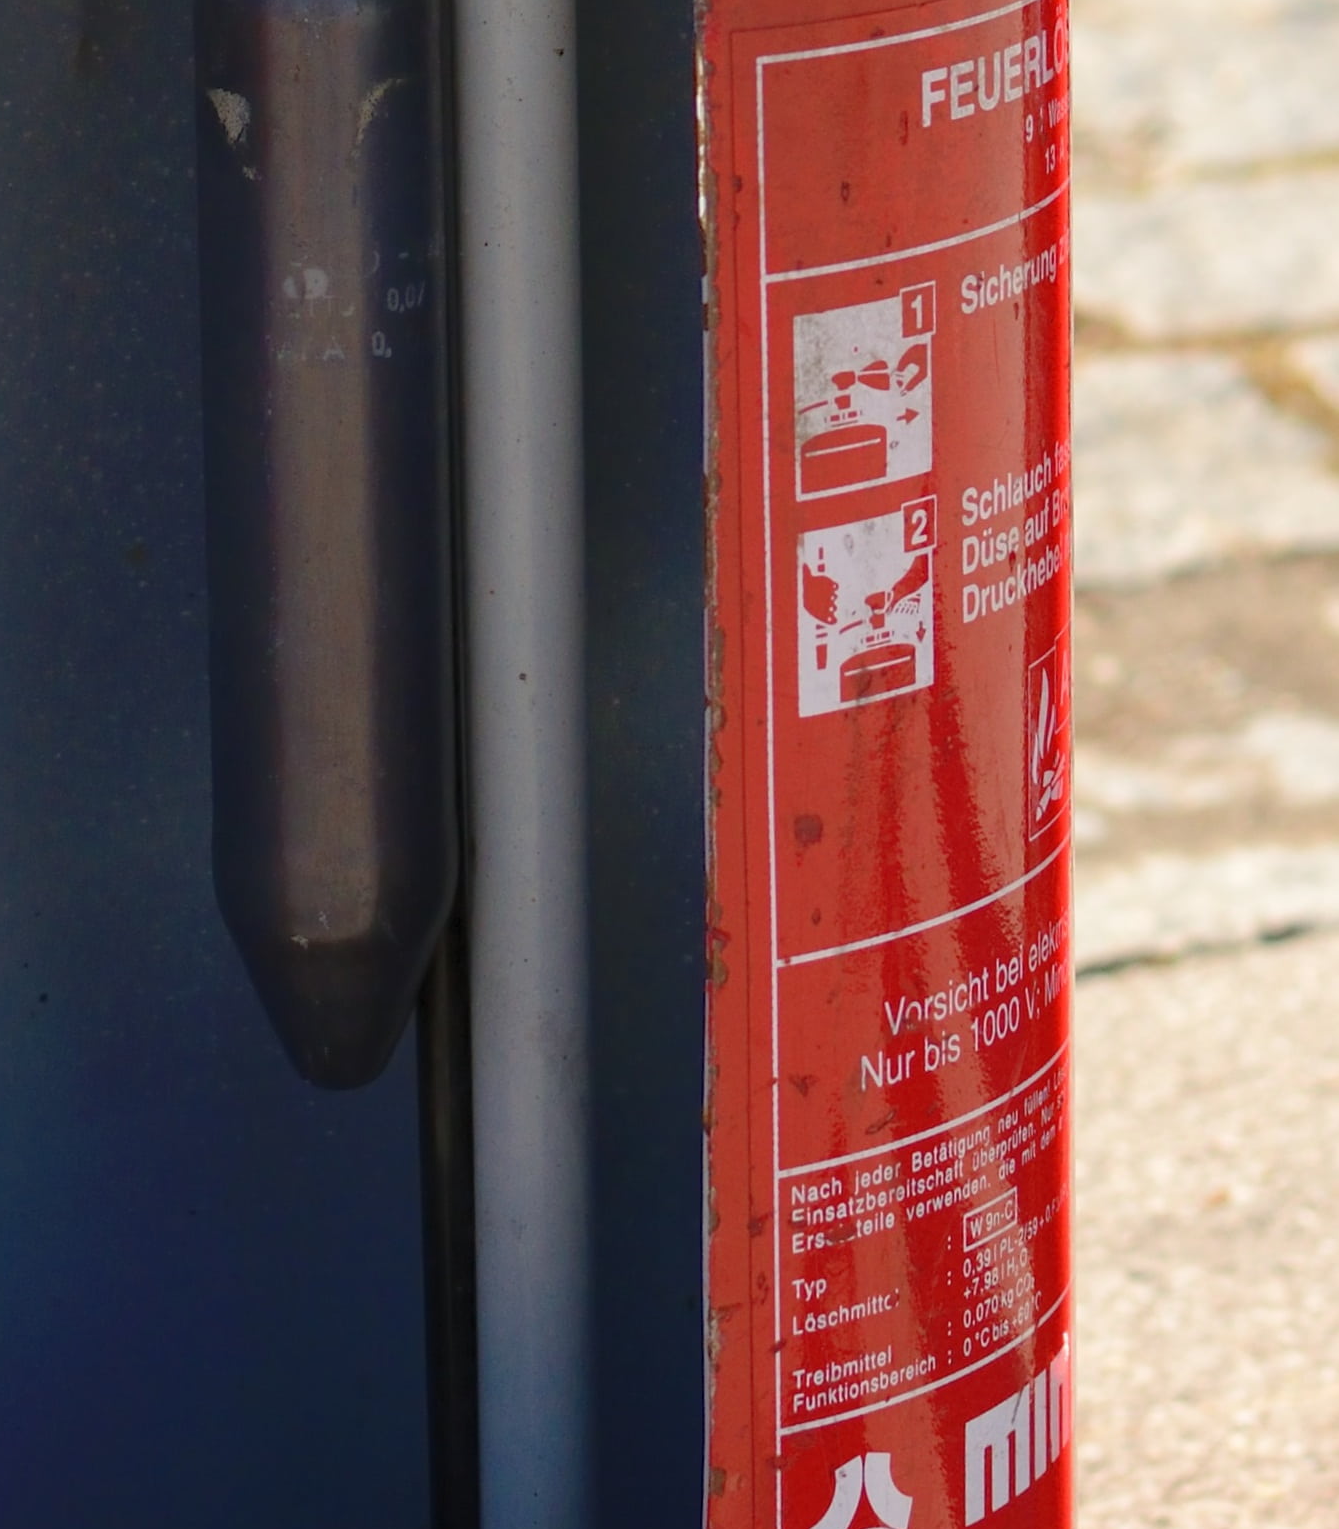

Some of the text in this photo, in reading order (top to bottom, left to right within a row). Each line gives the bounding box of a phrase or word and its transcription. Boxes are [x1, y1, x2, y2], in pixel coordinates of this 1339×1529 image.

[922, 6, 1068, 127] FEUERLÖ
[1025, 114, 1034, 143] 9
[1044, 143, 1055, 175] 13
[911, 294, 923, 329] 1
[961, 244, 1057, 315] Sicherung
[910, 509, 927, 545] 2
[962, 451, 1052, 527] Schlauch
[962, 525, 1020, 575] Düse
[1025, 496, 1050, 547] auf
[885, 967, 989, 1035] Vorsicht
[996, 943, 1024, 994] bei
[861, 1049, 915, 1092] Nur
[924, 1031, 961, 1072] bis
[970, 996, 1020, 1052] 1000
[791, 1177, 842, 1206] Nach
[854, 1163, 901, 1196] jeder
[911, 1126, 990, 1173] Betätigung
[998, 1109, 1019, 1134] neu
[791, 1158, 964, 1226] Einsatzbereitschaft
[791, 1211, 895, 1255] Ersteile
[998, 1158, 1016, 1180] die
[1021, 1140, 1036, 1166] mit
[792, 1277, 827, 1301] Typ
[970, 1216, 984, 1239] W
[792, 1344, 892, 1389] Treibmittel
[1001, 1288, 1014, 1309] kg
[792, 1354, 937, 1414] Funktionsbereich
[963, 1337, 972, 1358] 0
[992, 1318, 1010, 1341] bis
